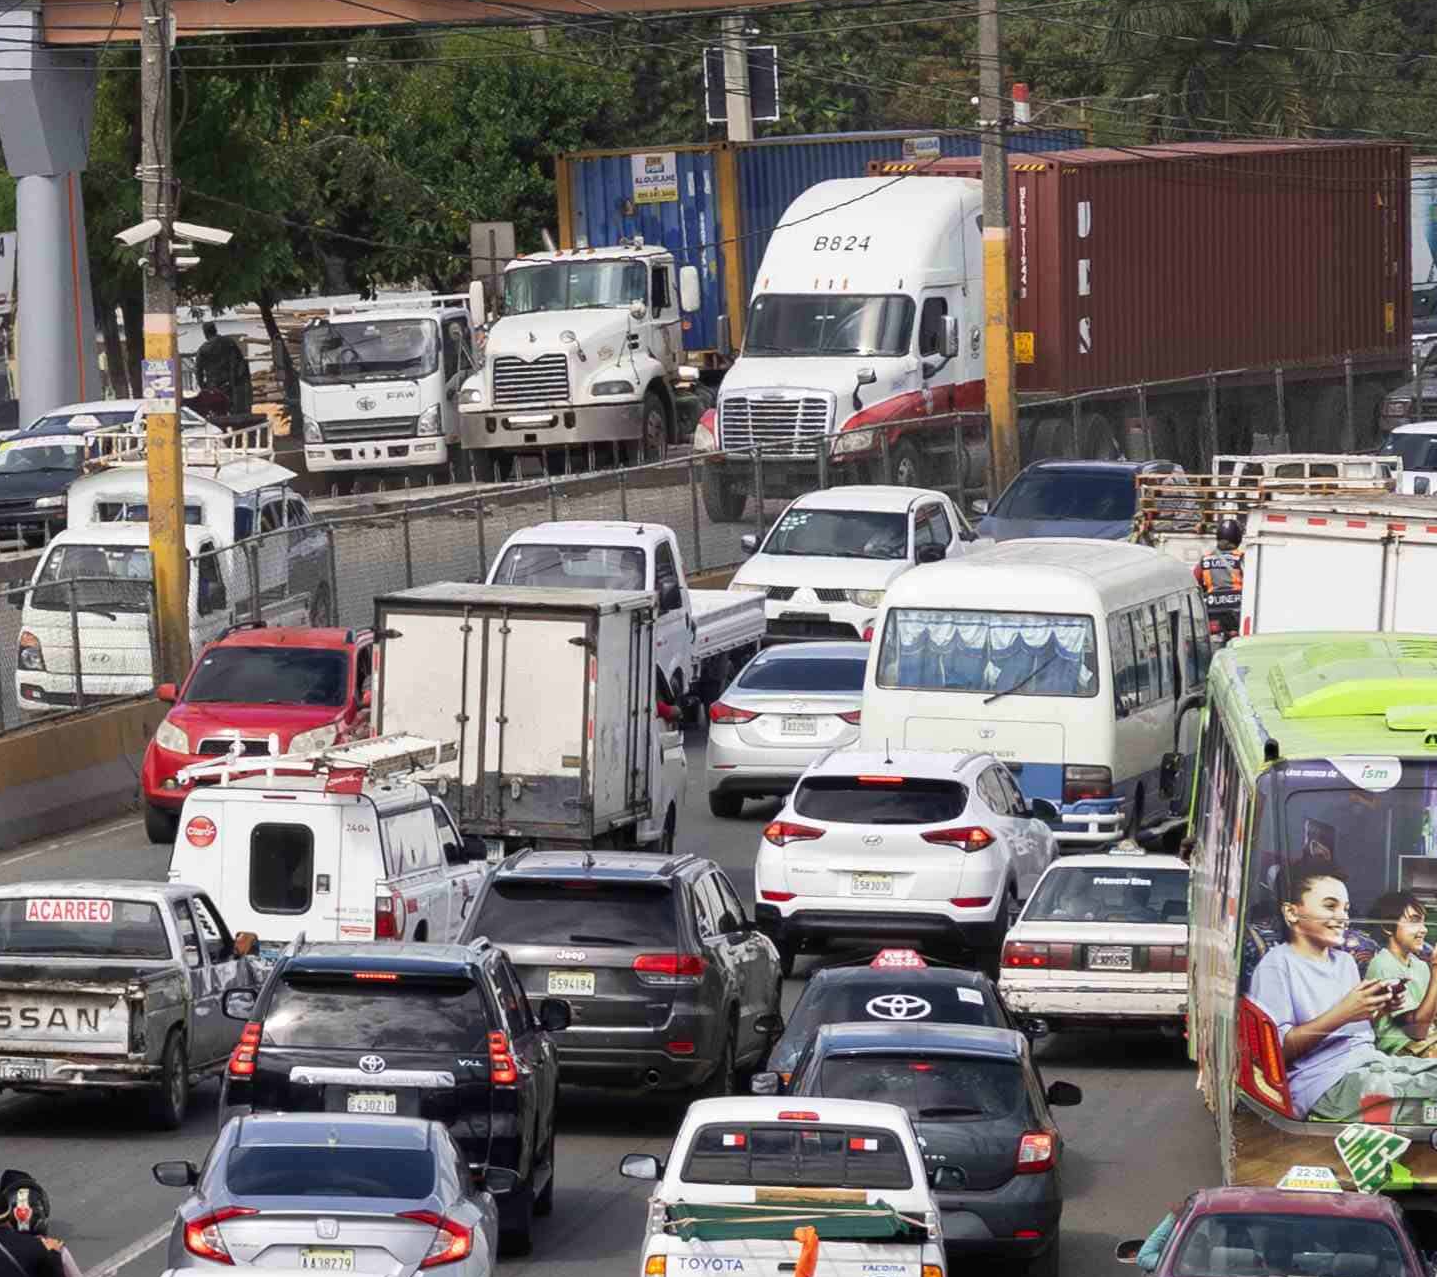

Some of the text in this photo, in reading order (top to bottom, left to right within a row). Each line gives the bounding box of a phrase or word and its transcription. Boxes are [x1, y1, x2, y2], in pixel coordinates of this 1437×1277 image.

[813, 235, 871, 253] B824
[1361, 764, 1389, 780] ism
[28, 901, 112, 920] ACARREO
[556, 949, 586, 962] Jeep
[679, 1257, 745, 1272] TOYOTA
